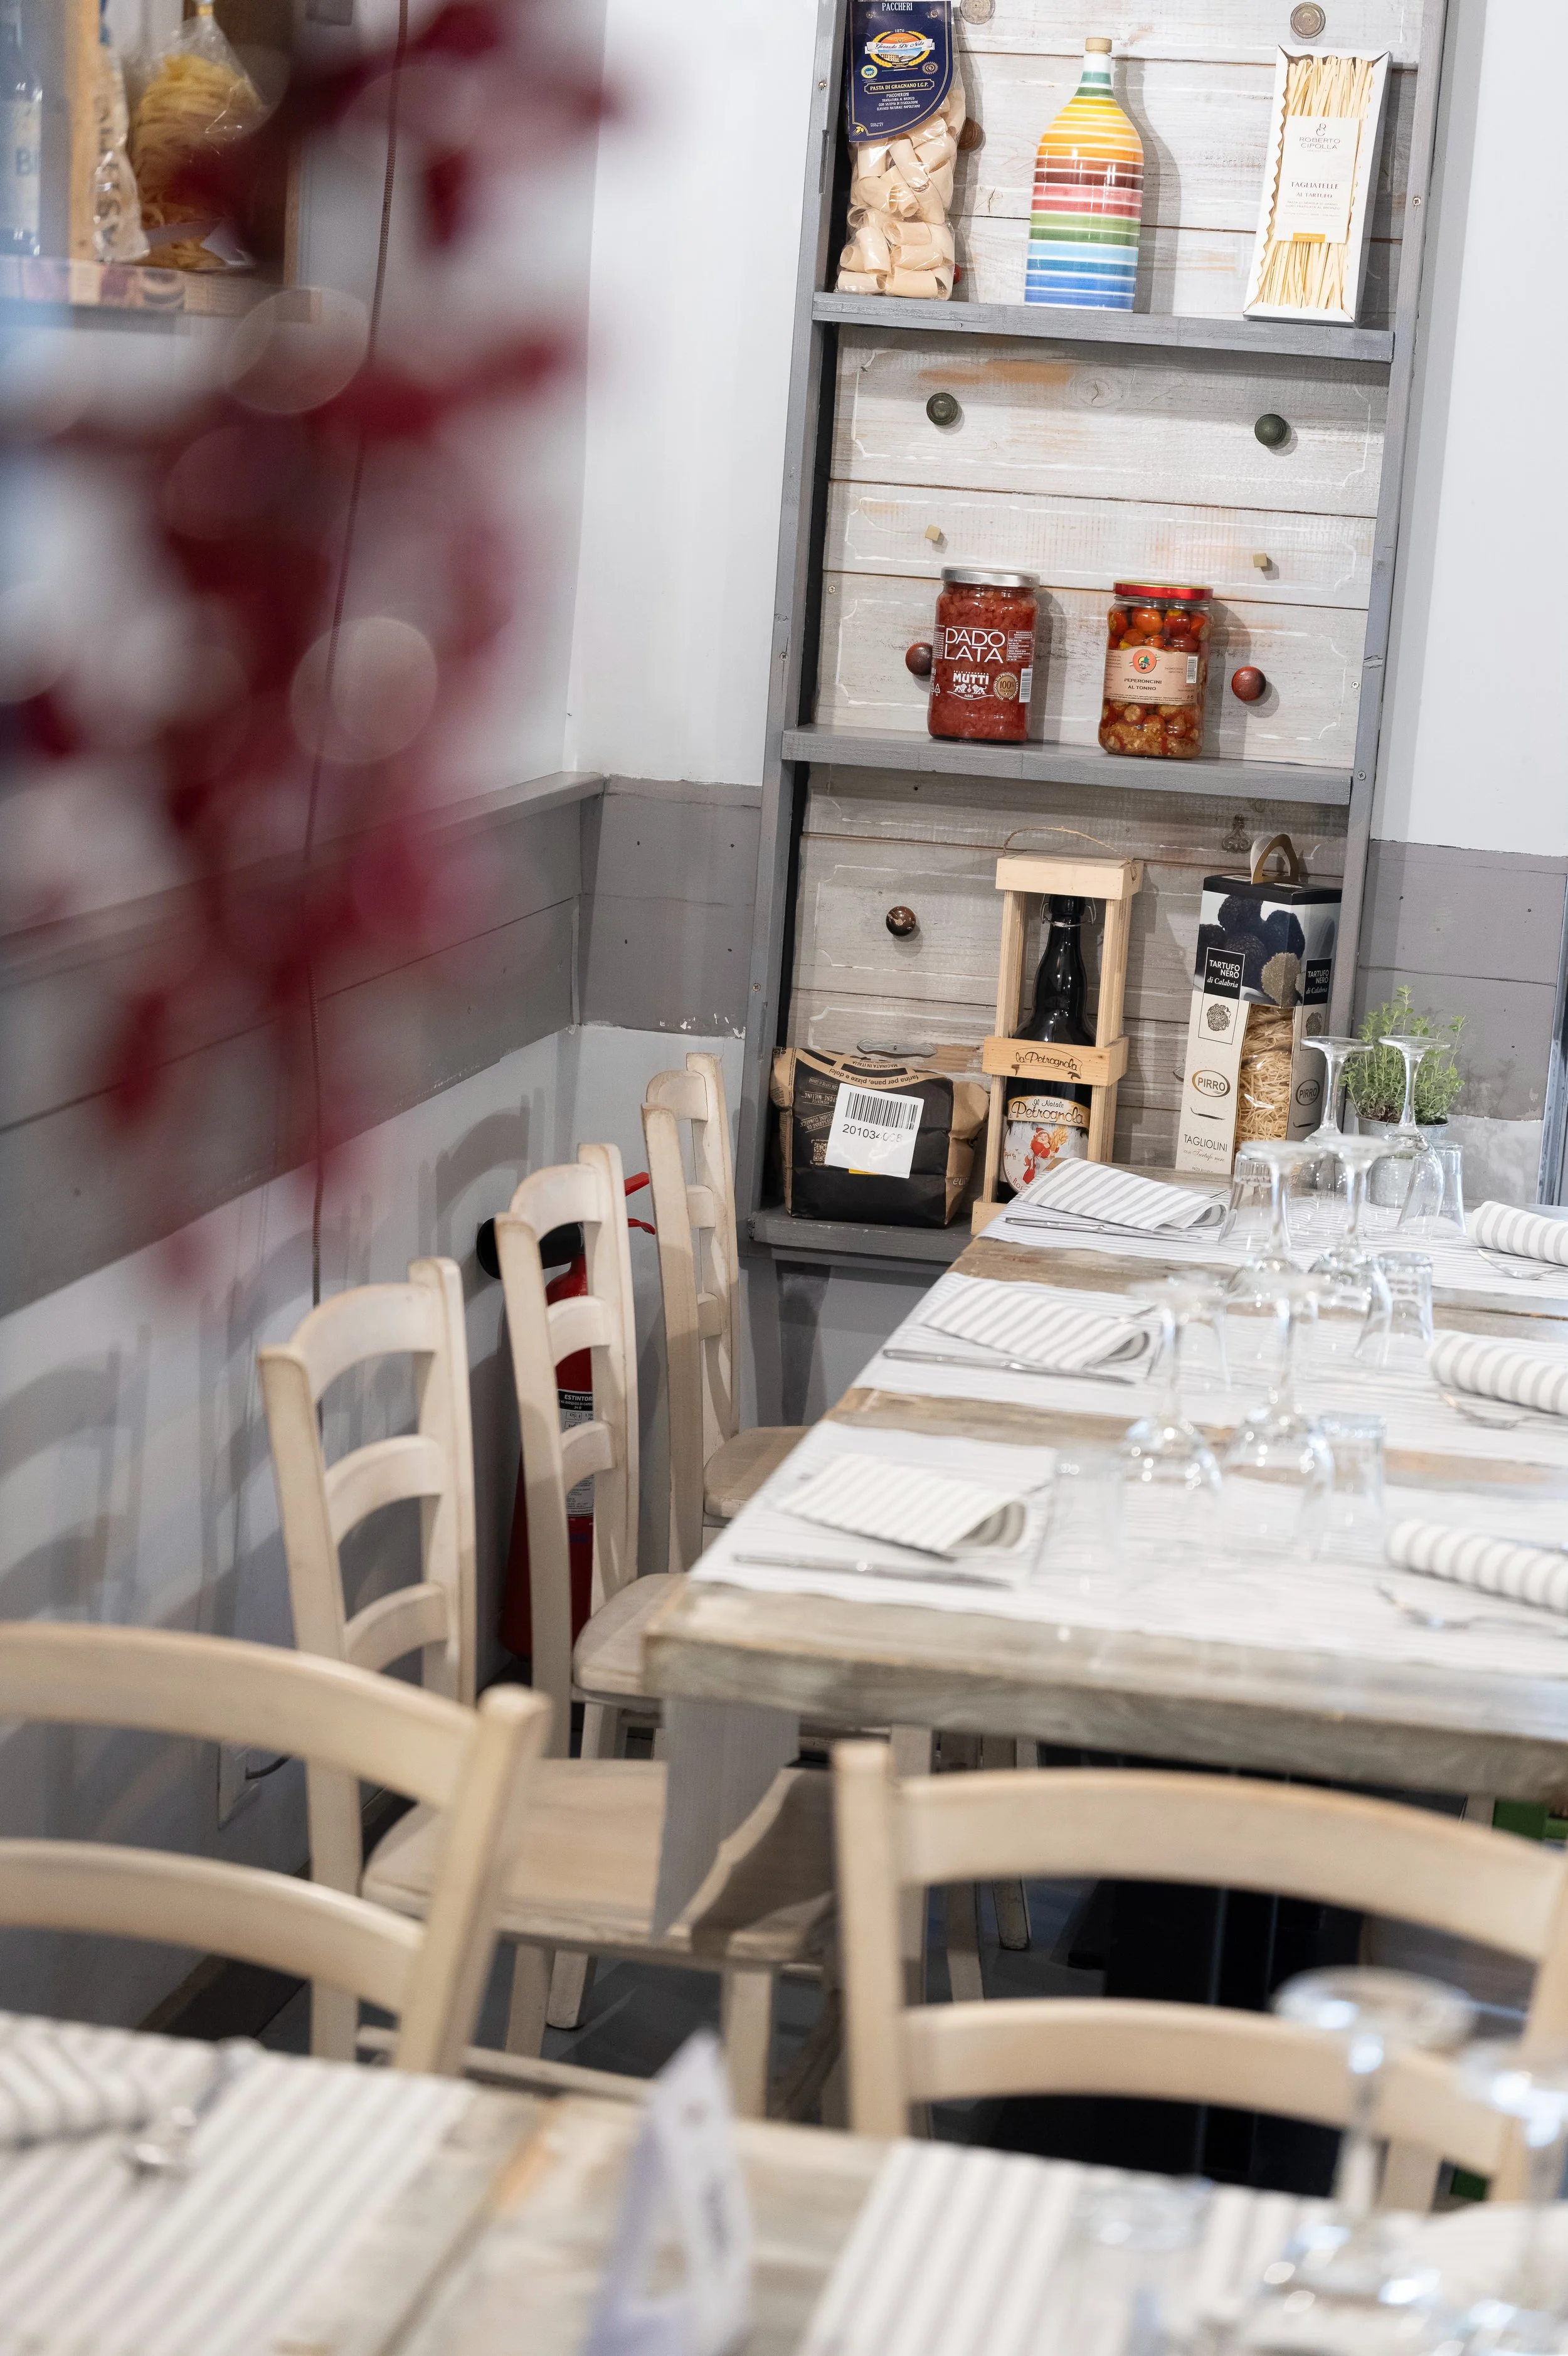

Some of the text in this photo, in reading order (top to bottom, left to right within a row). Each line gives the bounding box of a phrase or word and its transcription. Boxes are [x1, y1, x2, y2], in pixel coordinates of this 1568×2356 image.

[882, 3, 913, 11] PACCHERI
[1299, 137, 1340, 145] ROBERTO
[1291, 181, 1340, 189] TAGLIATELLE
[945, 628, 1005, 647] DADO
[945, 644, 1004, 664] LATA
[953, 672, 989, 685] MUTTI
[1000, 681, 1015, 689] 100%
[1209, 960, 1240, 972] TARTUFO
[1221, 970, 1239, 979] NERO
[1308, 970, 1330, 978] TARTUFO
[1214, 978, 1239, 989] Calabria
[1025, 1051, 1078, 1071] Petrognola
[829, 1068, 844, 1078] dolci
[850, 1076, 867, 1085] pizze
[901, 1075, 919, 1083] farina
[1197, 1077, 1226, 1091] PIRRO
[1299, 1087, 1316, 1098] PIRRO
[1041, 1100, 1064, 1108] Natale
[1011, 1100, 1083, 1124] Petrognola
[1184, 1133, 1227, 1152] TAGLIOLINI
[1193, 1149, 1213, 1161] Tartufo
[1012, 1178, 1024, 1191] Ros
